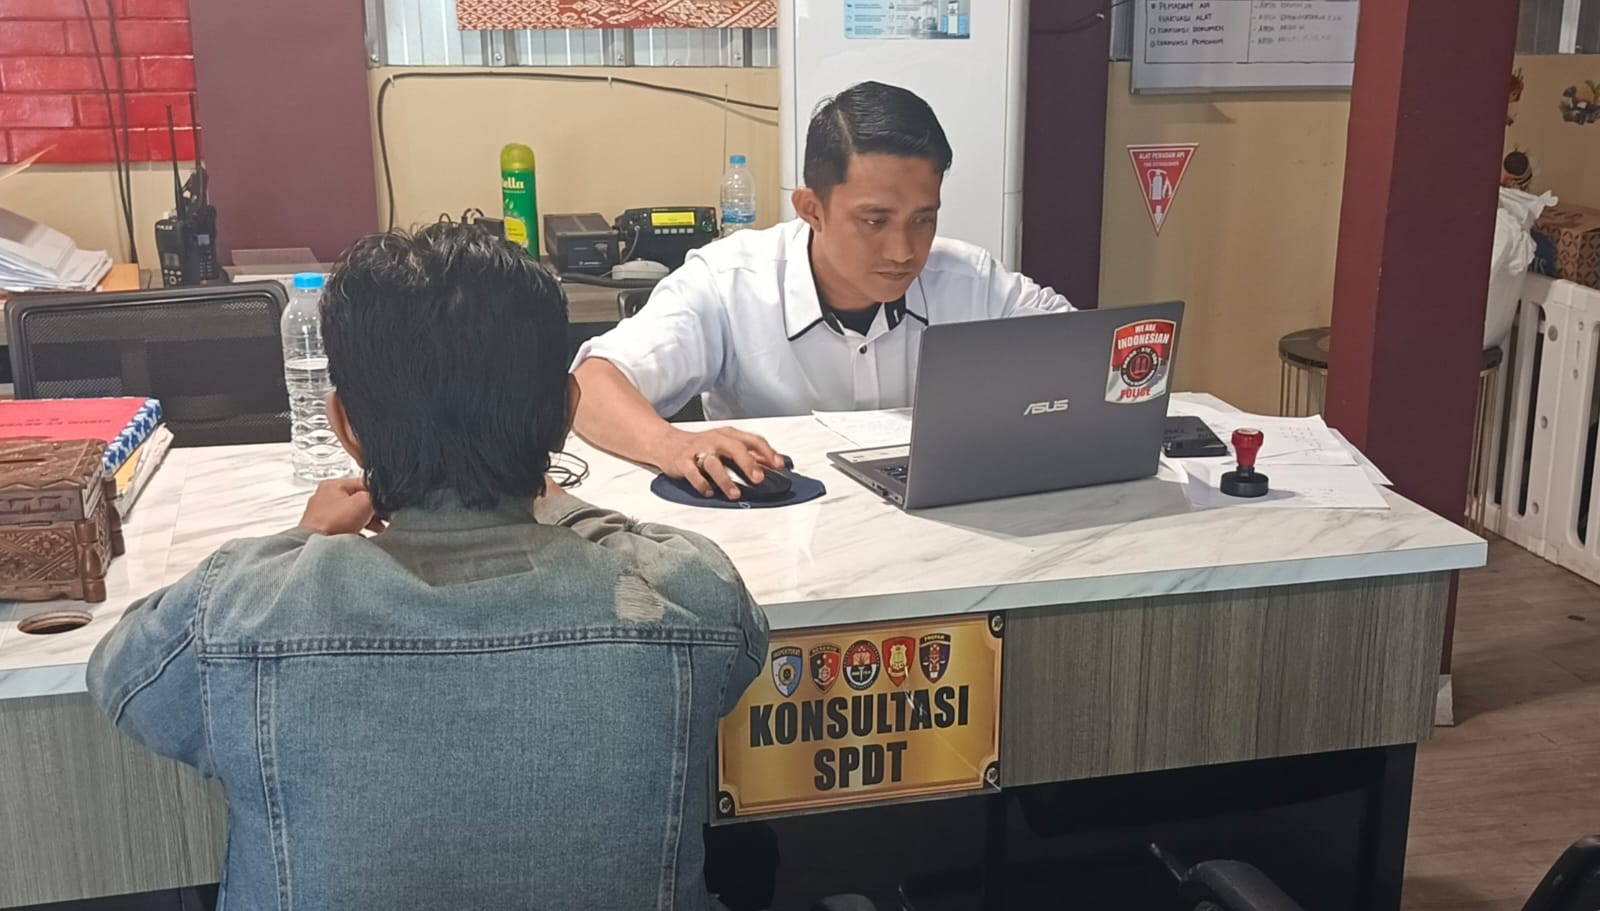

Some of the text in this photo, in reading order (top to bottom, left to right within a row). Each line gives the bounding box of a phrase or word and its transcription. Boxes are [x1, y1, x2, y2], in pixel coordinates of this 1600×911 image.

[503, 176, 524, 189] ella
[1145, 323, 1157, 332] ARE
[1117, 332, 1170, 350] INDONESIAN
[1120, 386, 1153, 400] POLICE
[1024, 399, 1069, 415] ASUS
[750, 685, 969, 747] KONSULTASI
[814, 741, 907, 791] SPDT
